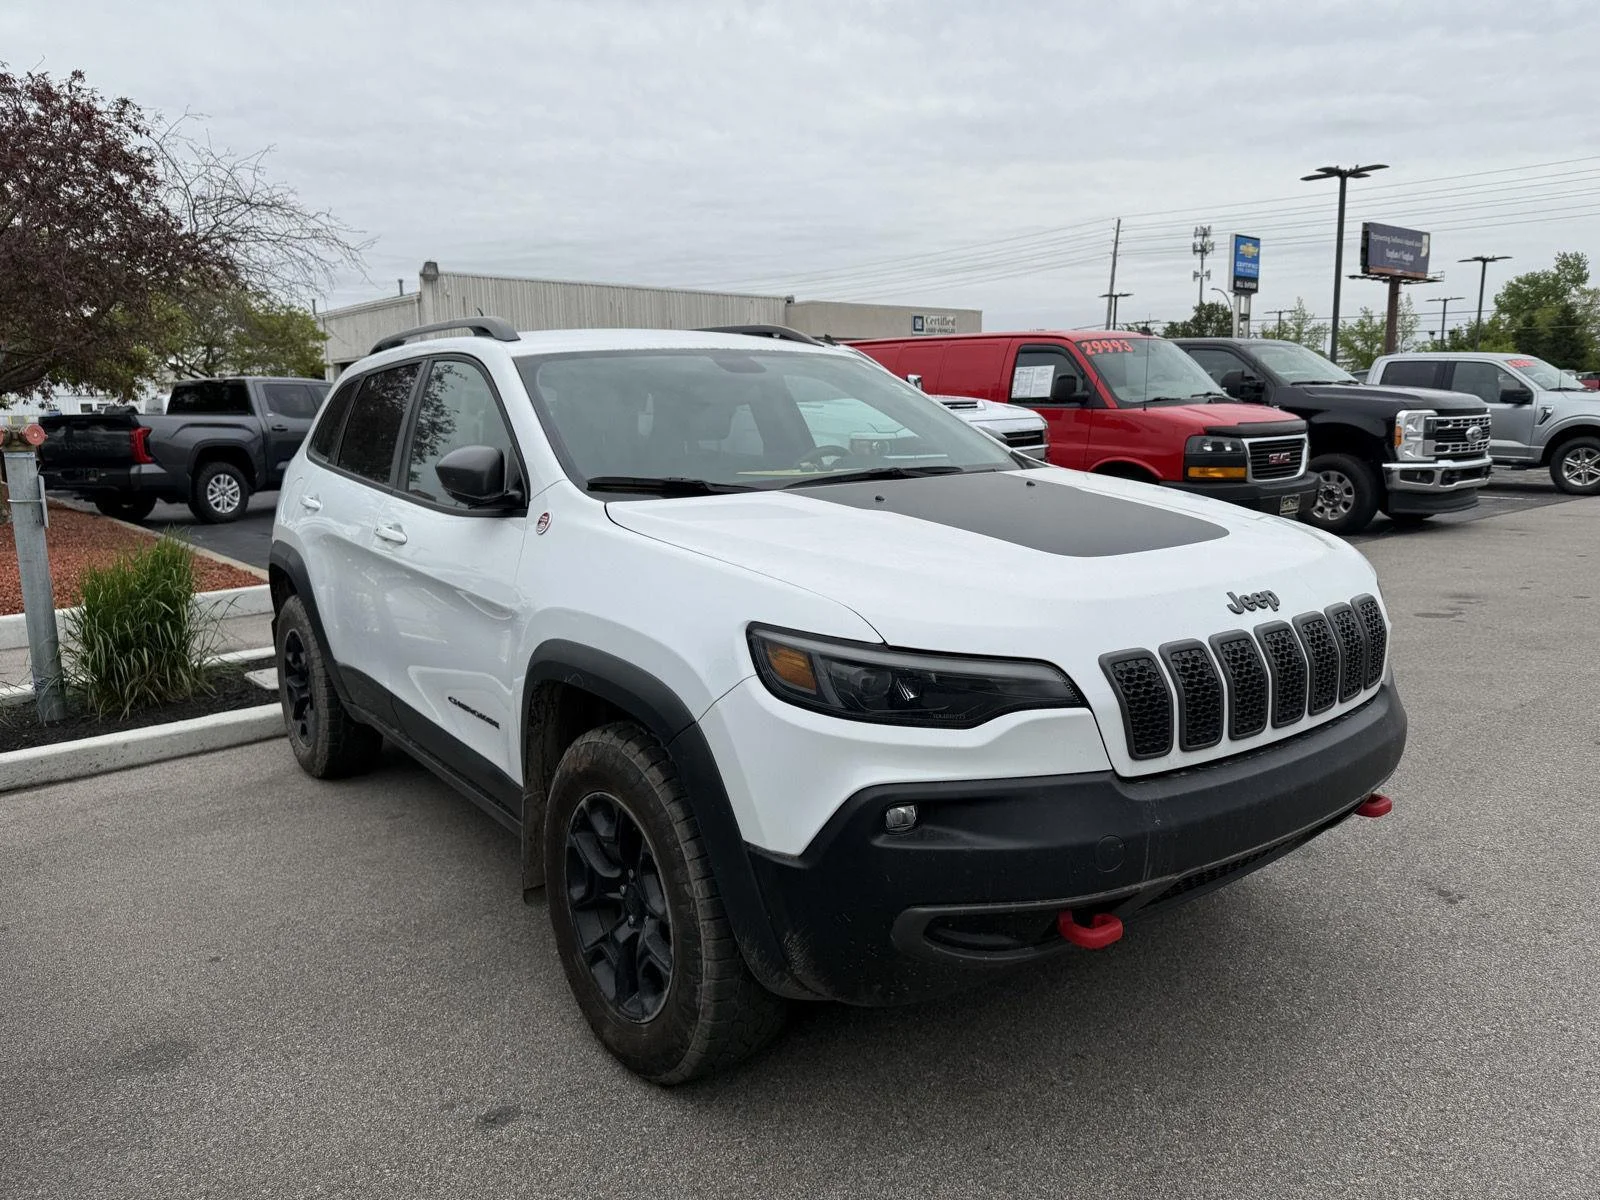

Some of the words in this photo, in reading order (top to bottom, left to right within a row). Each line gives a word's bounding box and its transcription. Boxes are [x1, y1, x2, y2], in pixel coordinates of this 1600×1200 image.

[925, 316, 956, 326] Certified
[1081, 340, 1134, 356] 29993
[1226, 590, 1280, 614] Jeep
